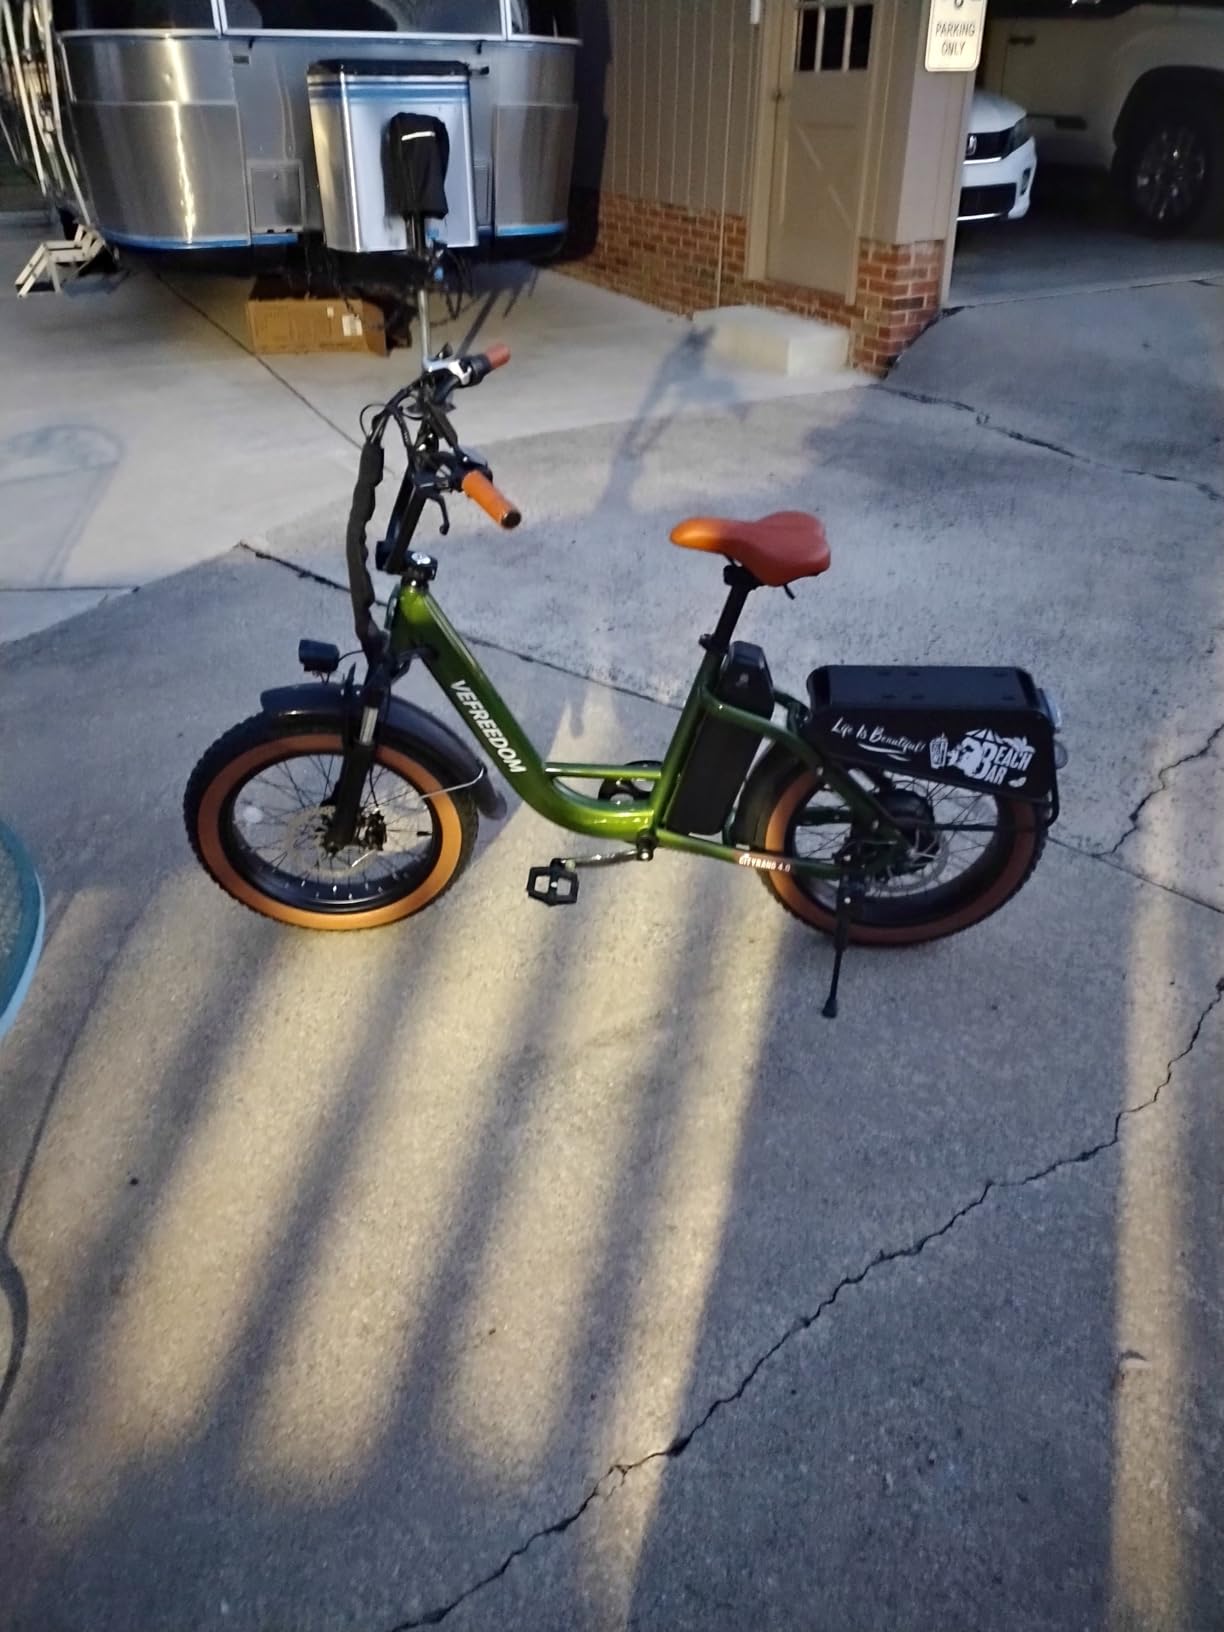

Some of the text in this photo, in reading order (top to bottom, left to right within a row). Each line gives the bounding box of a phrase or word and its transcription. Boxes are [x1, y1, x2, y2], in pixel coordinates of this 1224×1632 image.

[935, 23, 975, 37] PARKING
[941, 41, 966, 56] ONLY
[451, 680, 527, 773] VEFREEDOM
[831, 716, 853, 739] Life
